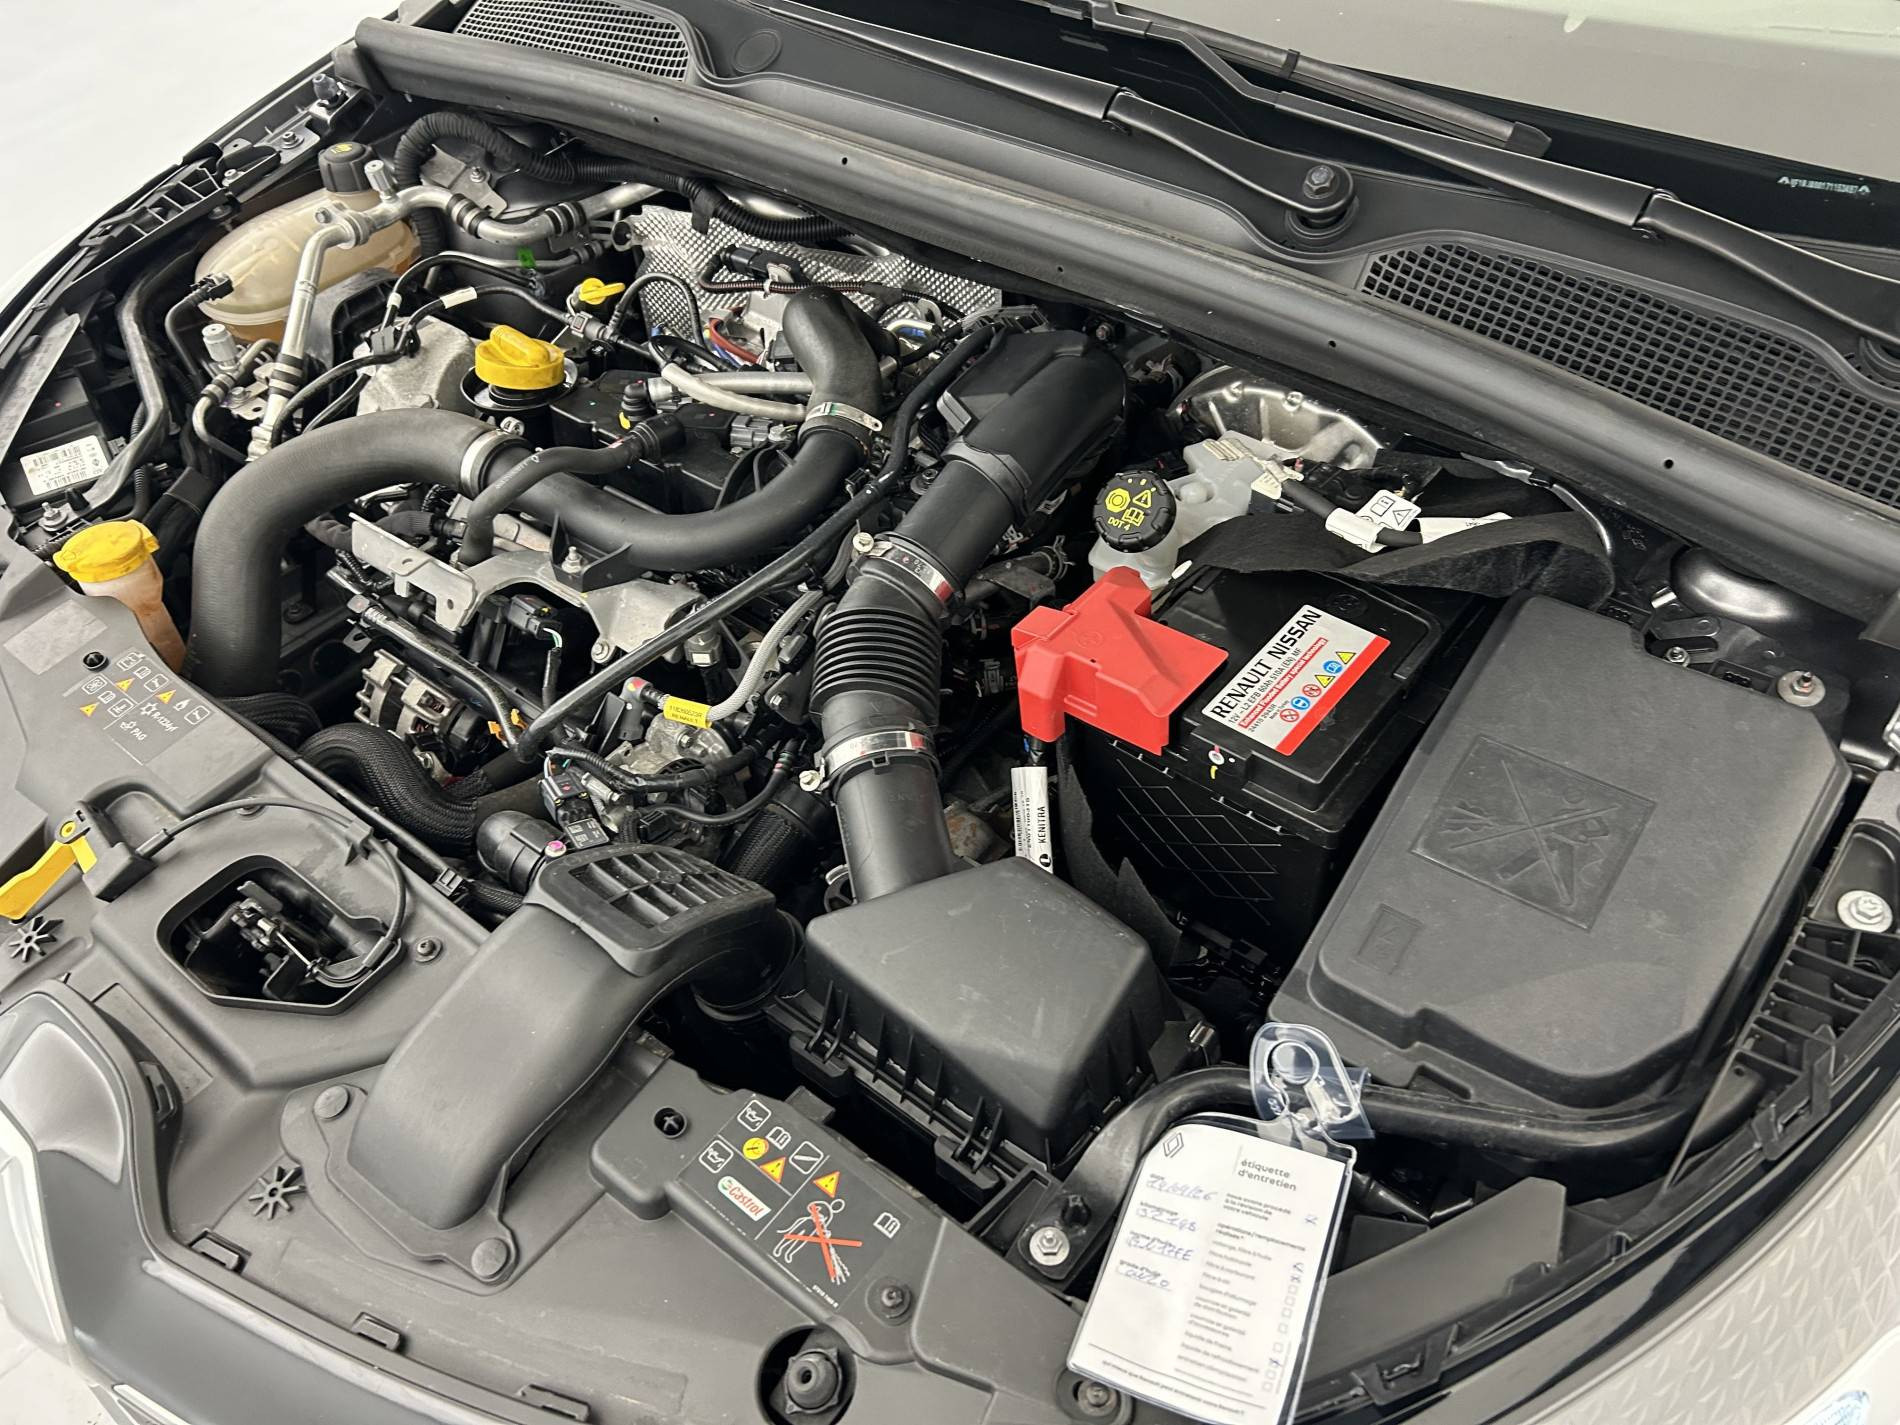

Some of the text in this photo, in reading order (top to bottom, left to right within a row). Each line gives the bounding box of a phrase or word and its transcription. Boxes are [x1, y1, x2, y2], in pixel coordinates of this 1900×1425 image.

[1107, 516, 1131, 531] DOT 4
[1210, 609, 1321, 718] RENAULT NISSAN
[1228, 713, 1240, 723] 12V
[1240, 702, 1250, 710] L2
[1247, 691, 1261, 702] EFB
[1257, 679, 1273, 692] 60Ah
[1269, 666, 1284, 679] 510A
[1280, 656, 1296, 668] (EN)
[1291, 647, 1302, 656] MF
[1240, 704, 1262, 726] Enhanced
[1259, 687, 1278, 705] Flooded
[1274, 673, 1293, 689] Battery
[130, 727, 147, 741] PAG
[1037, 806, 1046, 844] KENITRA
[1238, 1169, 1297, 1191] d'entretien
[1241, 1159, 1291, 1179] étiquette
[729, 1186, 765, 1217] Castrol
